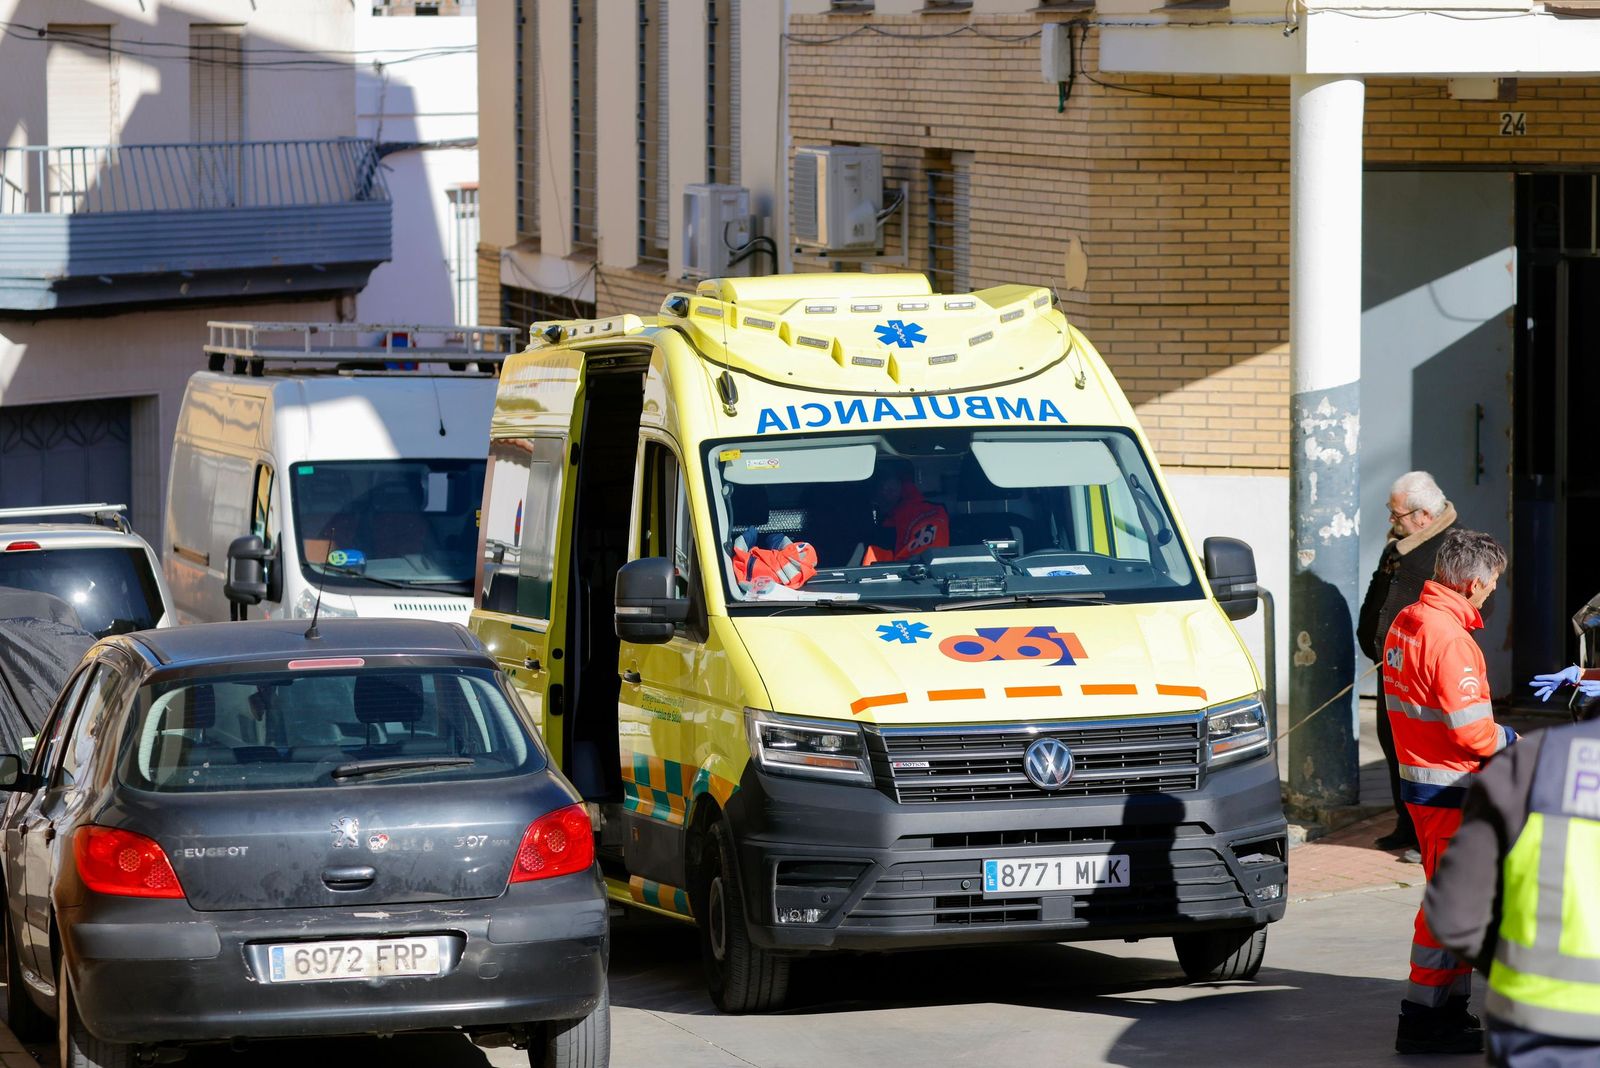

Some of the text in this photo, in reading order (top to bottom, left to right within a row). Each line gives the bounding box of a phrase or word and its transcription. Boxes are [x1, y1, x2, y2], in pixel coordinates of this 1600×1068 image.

[1502, 112, 1526, 135] 24
[938, 626, 1089, 666] 061
[174, 846, 249, 858] PEUGEOT
[454, 835, 489, 848] 307
[1001, 862, 1062, 887] 8771
[1076, 860, 1122, 885] MLK
[294, 946, 364, 975] 6972
[377, 943, 428, 972] FRP
